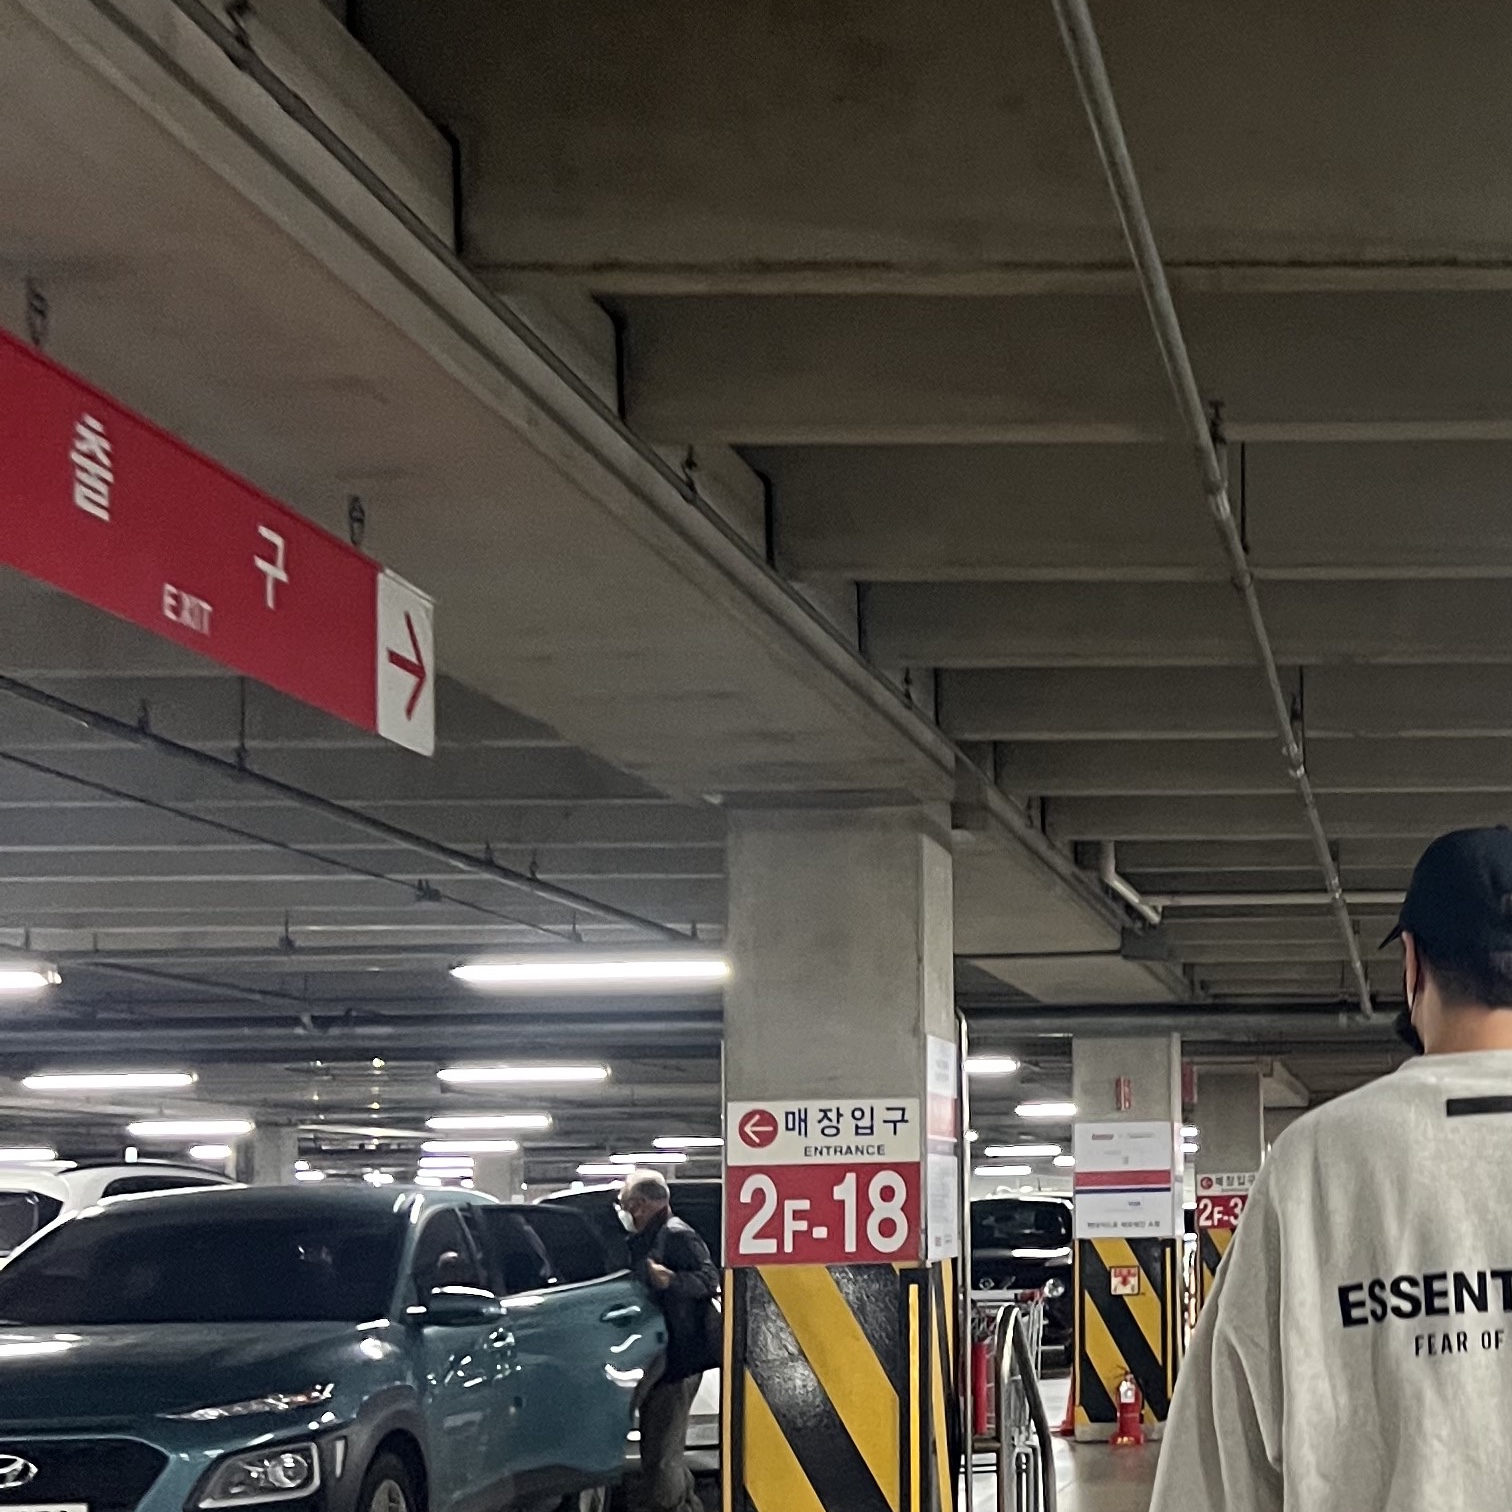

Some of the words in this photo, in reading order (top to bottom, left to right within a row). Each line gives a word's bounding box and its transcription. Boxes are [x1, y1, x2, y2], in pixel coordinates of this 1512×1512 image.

[162, 581, 213, 638] EXIT
[784, 1105, 910, 1138] 매장입구
[803, 1143, 887, 1158] ENTRANCE
[738, 1169, 909, 1255] 2F-18
[1414, 1330, 1468, 1357] FEAR
[1480, 1329, 1505, 1351] OF
